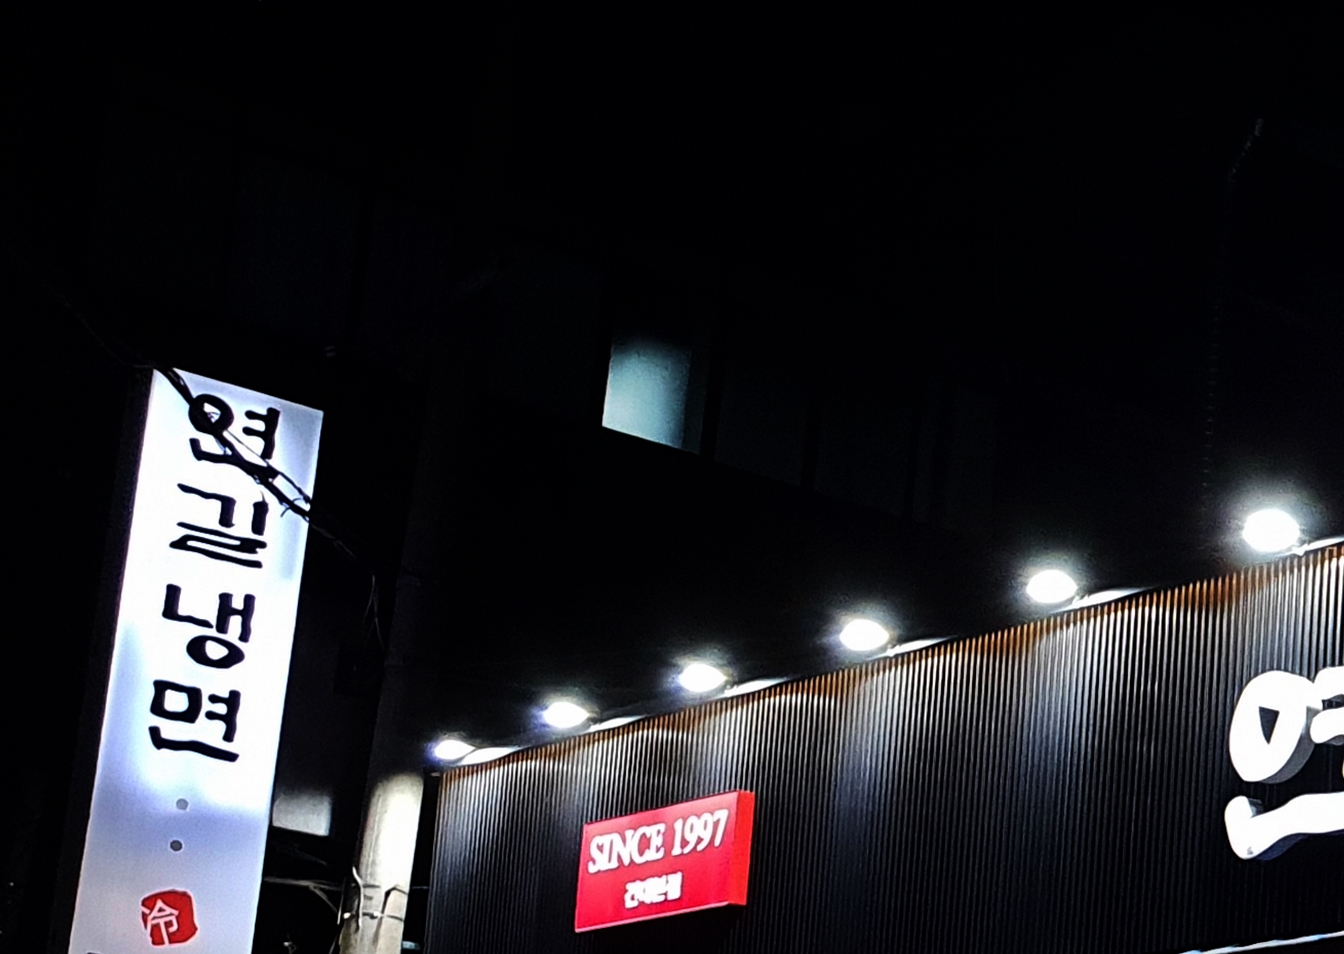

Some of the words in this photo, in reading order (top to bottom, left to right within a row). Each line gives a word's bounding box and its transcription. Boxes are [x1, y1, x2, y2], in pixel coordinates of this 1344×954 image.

[148, 393, 280, 763] 연길냉면
[588, 823, 666, 874] SINCE
[671, 809, 729, 857] 1997
